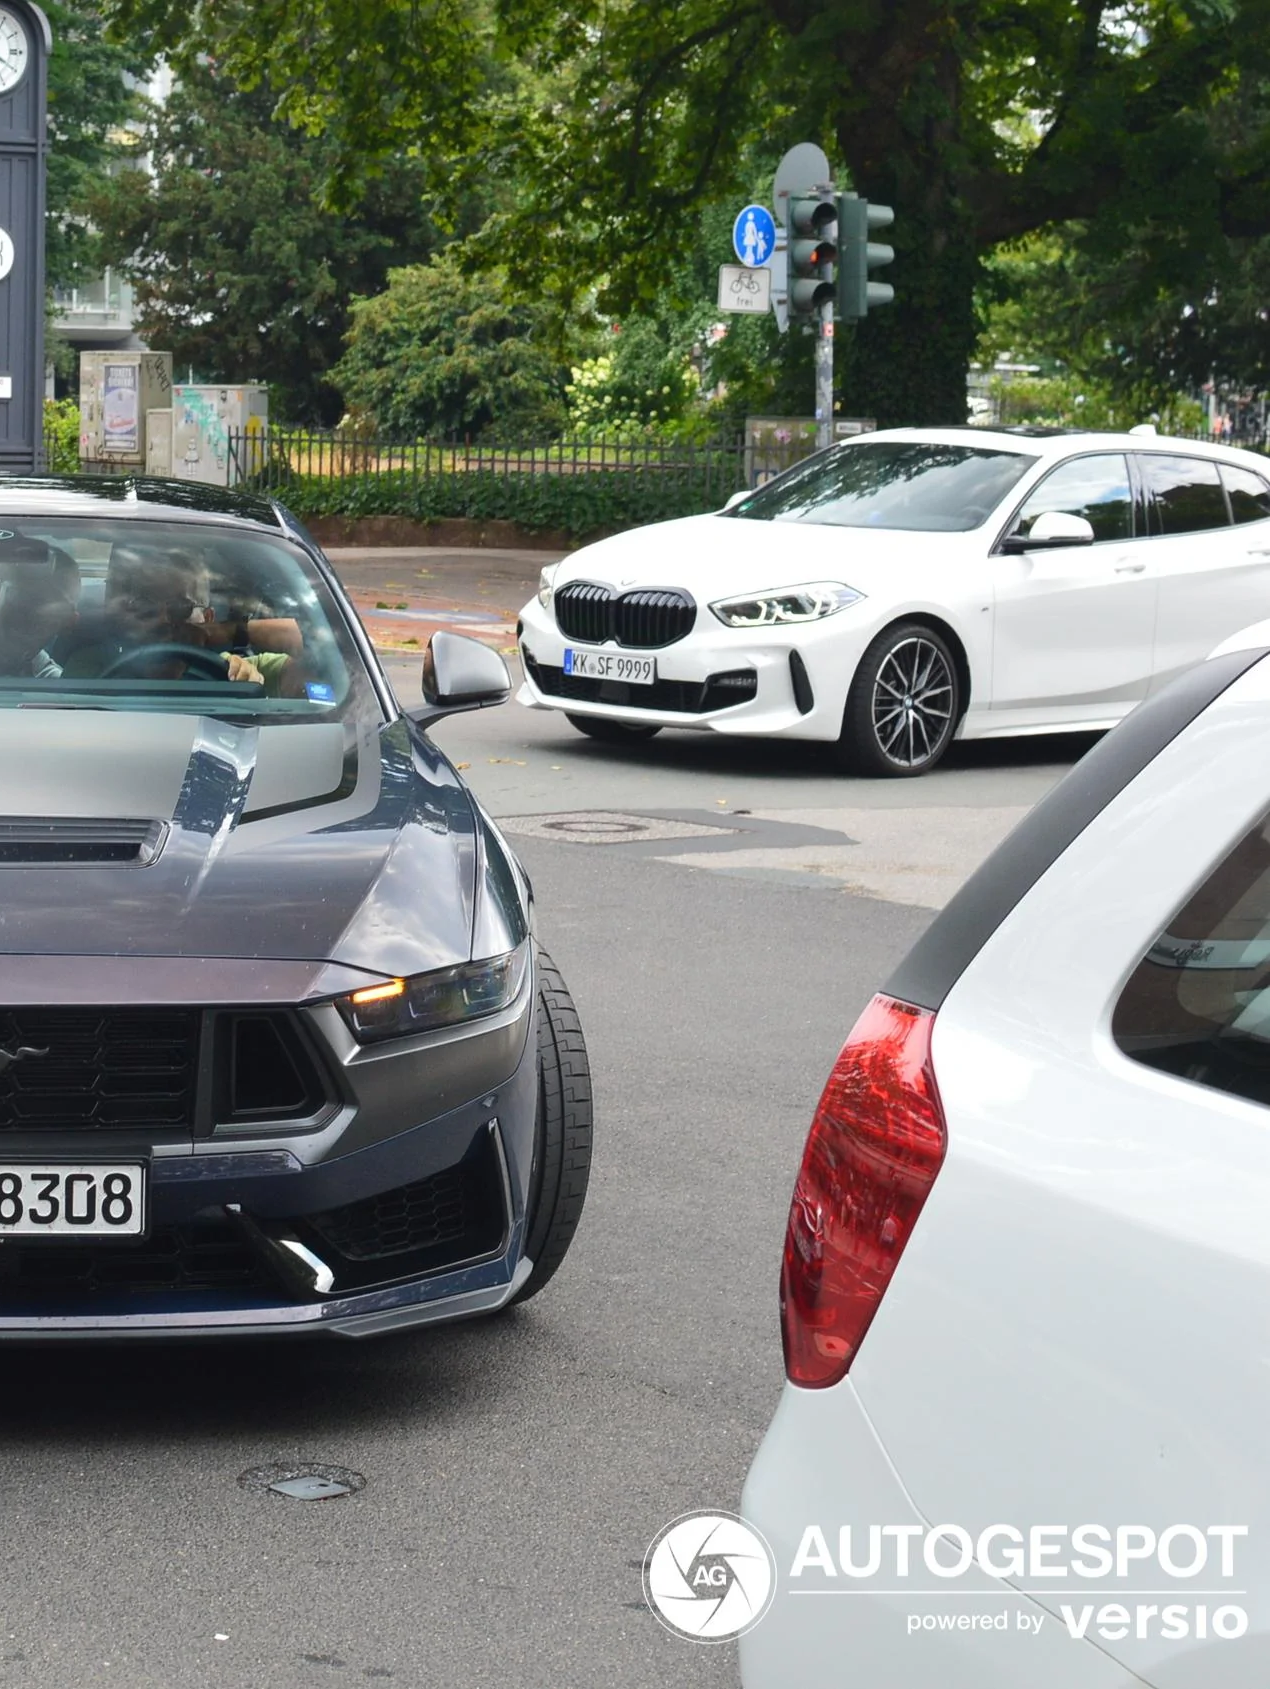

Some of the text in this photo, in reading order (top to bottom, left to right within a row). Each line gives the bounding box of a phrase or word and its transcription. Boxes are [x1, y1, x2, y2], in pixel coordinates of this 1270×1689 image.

[736, 297, 753, 307] frei
[573, 653, 651, 680] KK SF 9999
